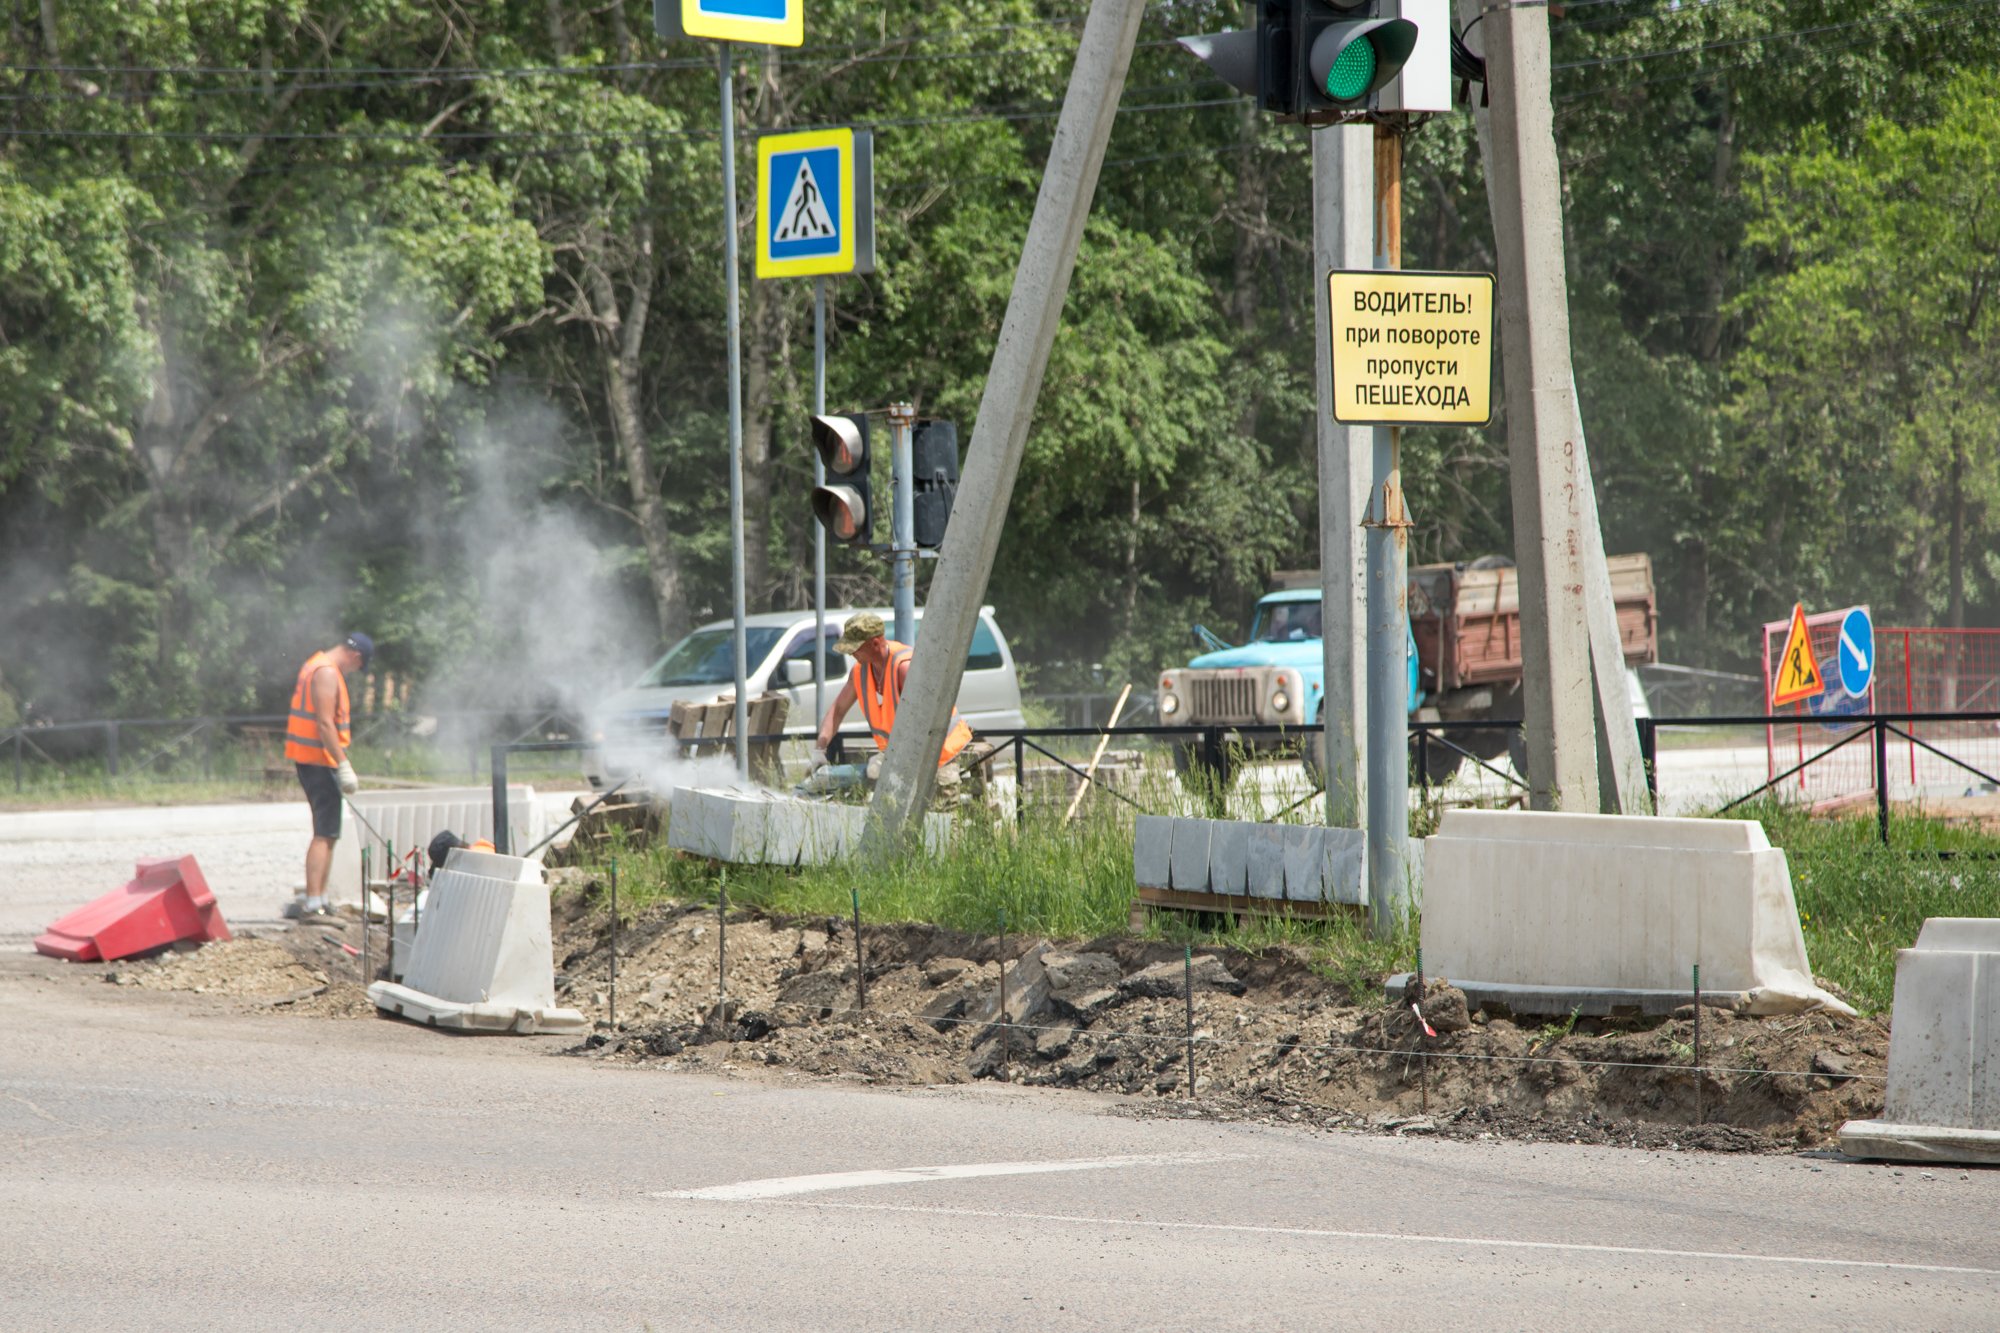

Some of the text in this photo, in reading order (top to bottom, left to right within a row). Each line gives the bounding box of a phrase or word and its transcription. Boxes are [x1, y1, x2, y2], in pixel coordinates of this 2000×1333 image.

[1354, 290, 1472, 317] ВОДИТЕЛЬ!
[1346, 327, 1481, 350] при повороте
[1367, 359, 1458, 380] пропусти
[1355, 384, 1471, 410] ПЕШЕХОДА
